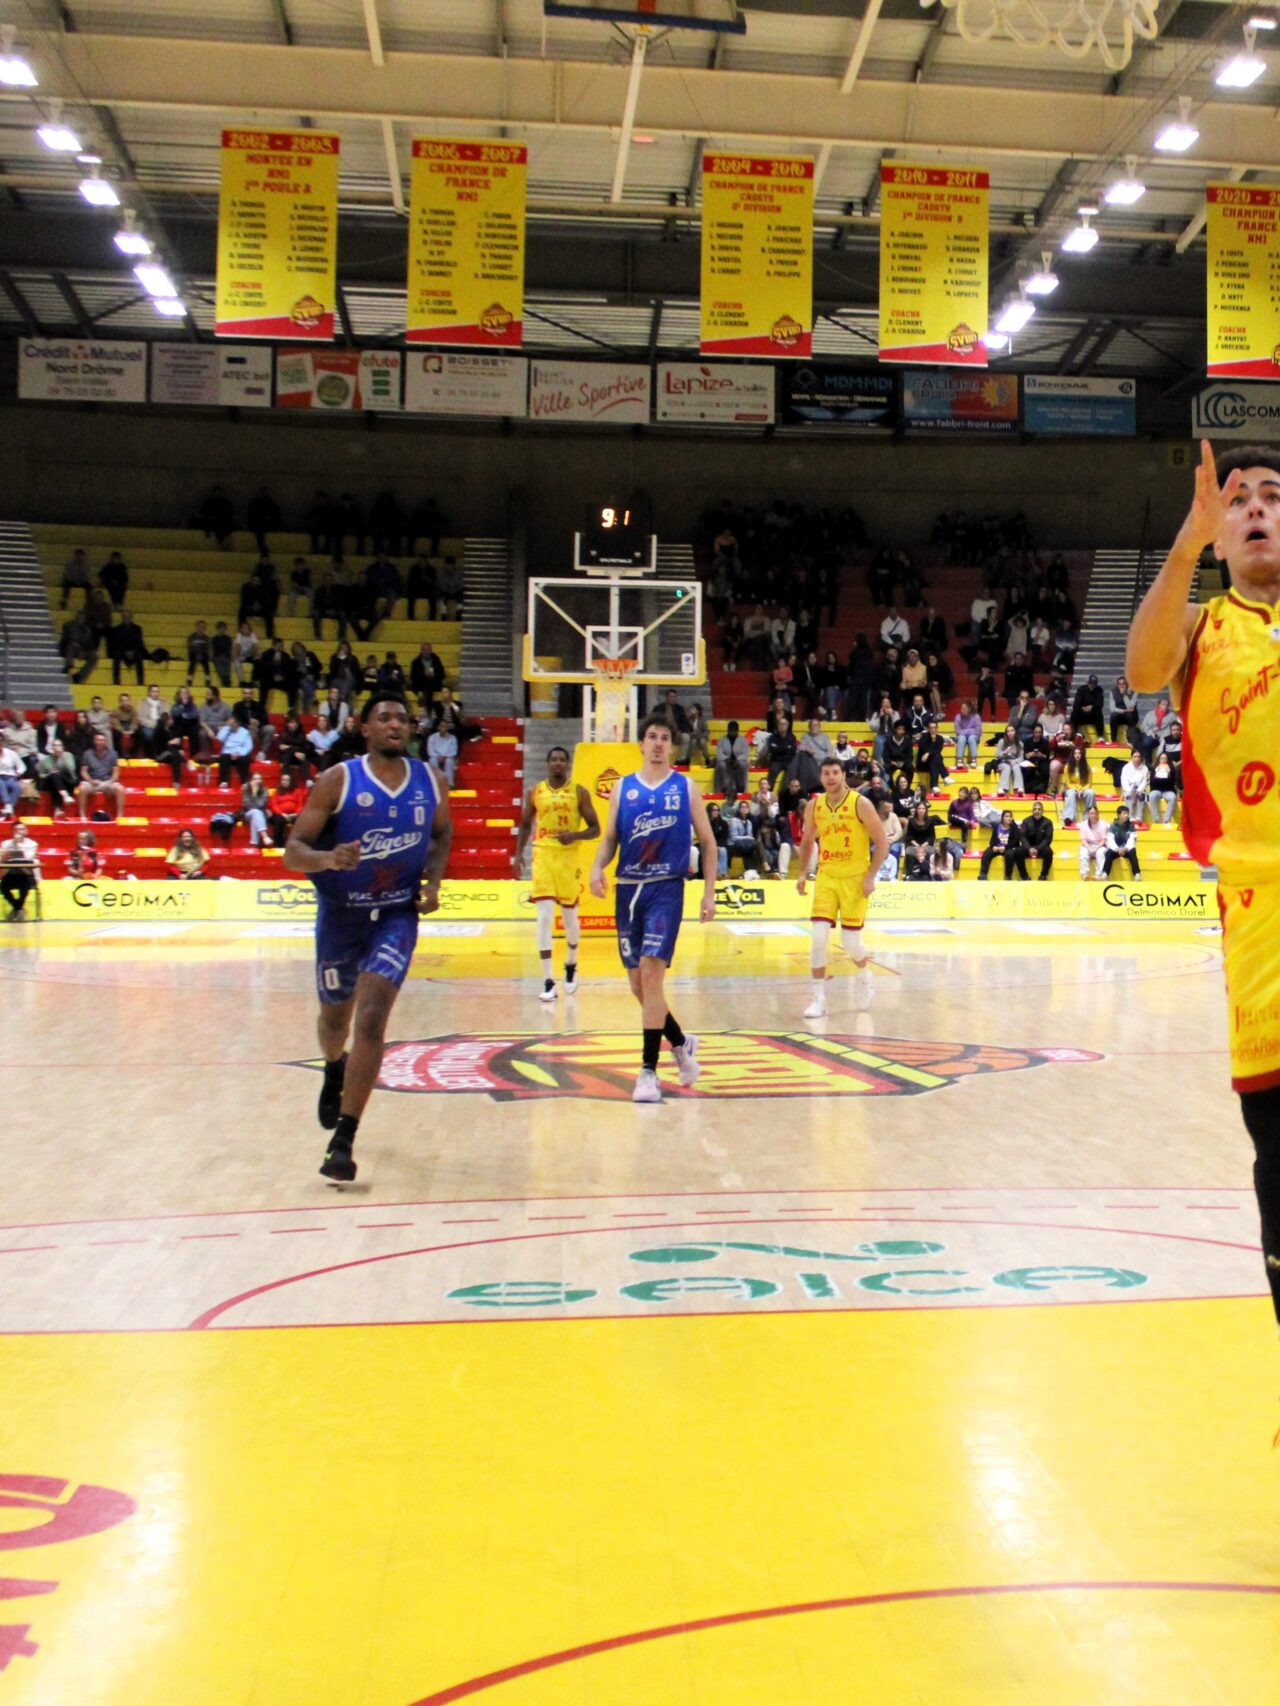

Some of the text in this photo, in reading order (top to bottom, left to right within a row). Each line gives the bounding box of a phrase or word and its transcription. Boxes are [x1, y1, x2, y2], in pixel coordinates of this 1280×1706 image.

[429, 163, 488, 176] CHAMPION
[712, 158, 805, 177] 2009 2010
[446, 177, 491, 189] FRANCE
[894, 168, 977, 188] 2010 2011
[709, 180, 805, 194] CHAMPION DE FRANCE
[888, 190, 980, 204] CHAMPION DE FRANCE
[1216, 190, 1251, 204] 2020
[1222, 207, 1276, 220] CHAMPION
[1237, 221, 1277, 233] FRANCE
[533, 376, 646, 417] Ville Sportive
[911, 417, 1012, 431] www.fabbri-froid.com
[664, 795, 681, 810] 13
[414, 806, 425, 825] 0
[628, 811, 677, 843] Tigers
[360, 827, 423, 859] Tigers
[1127, 907, 1206, 917] Delmonico Dorel
